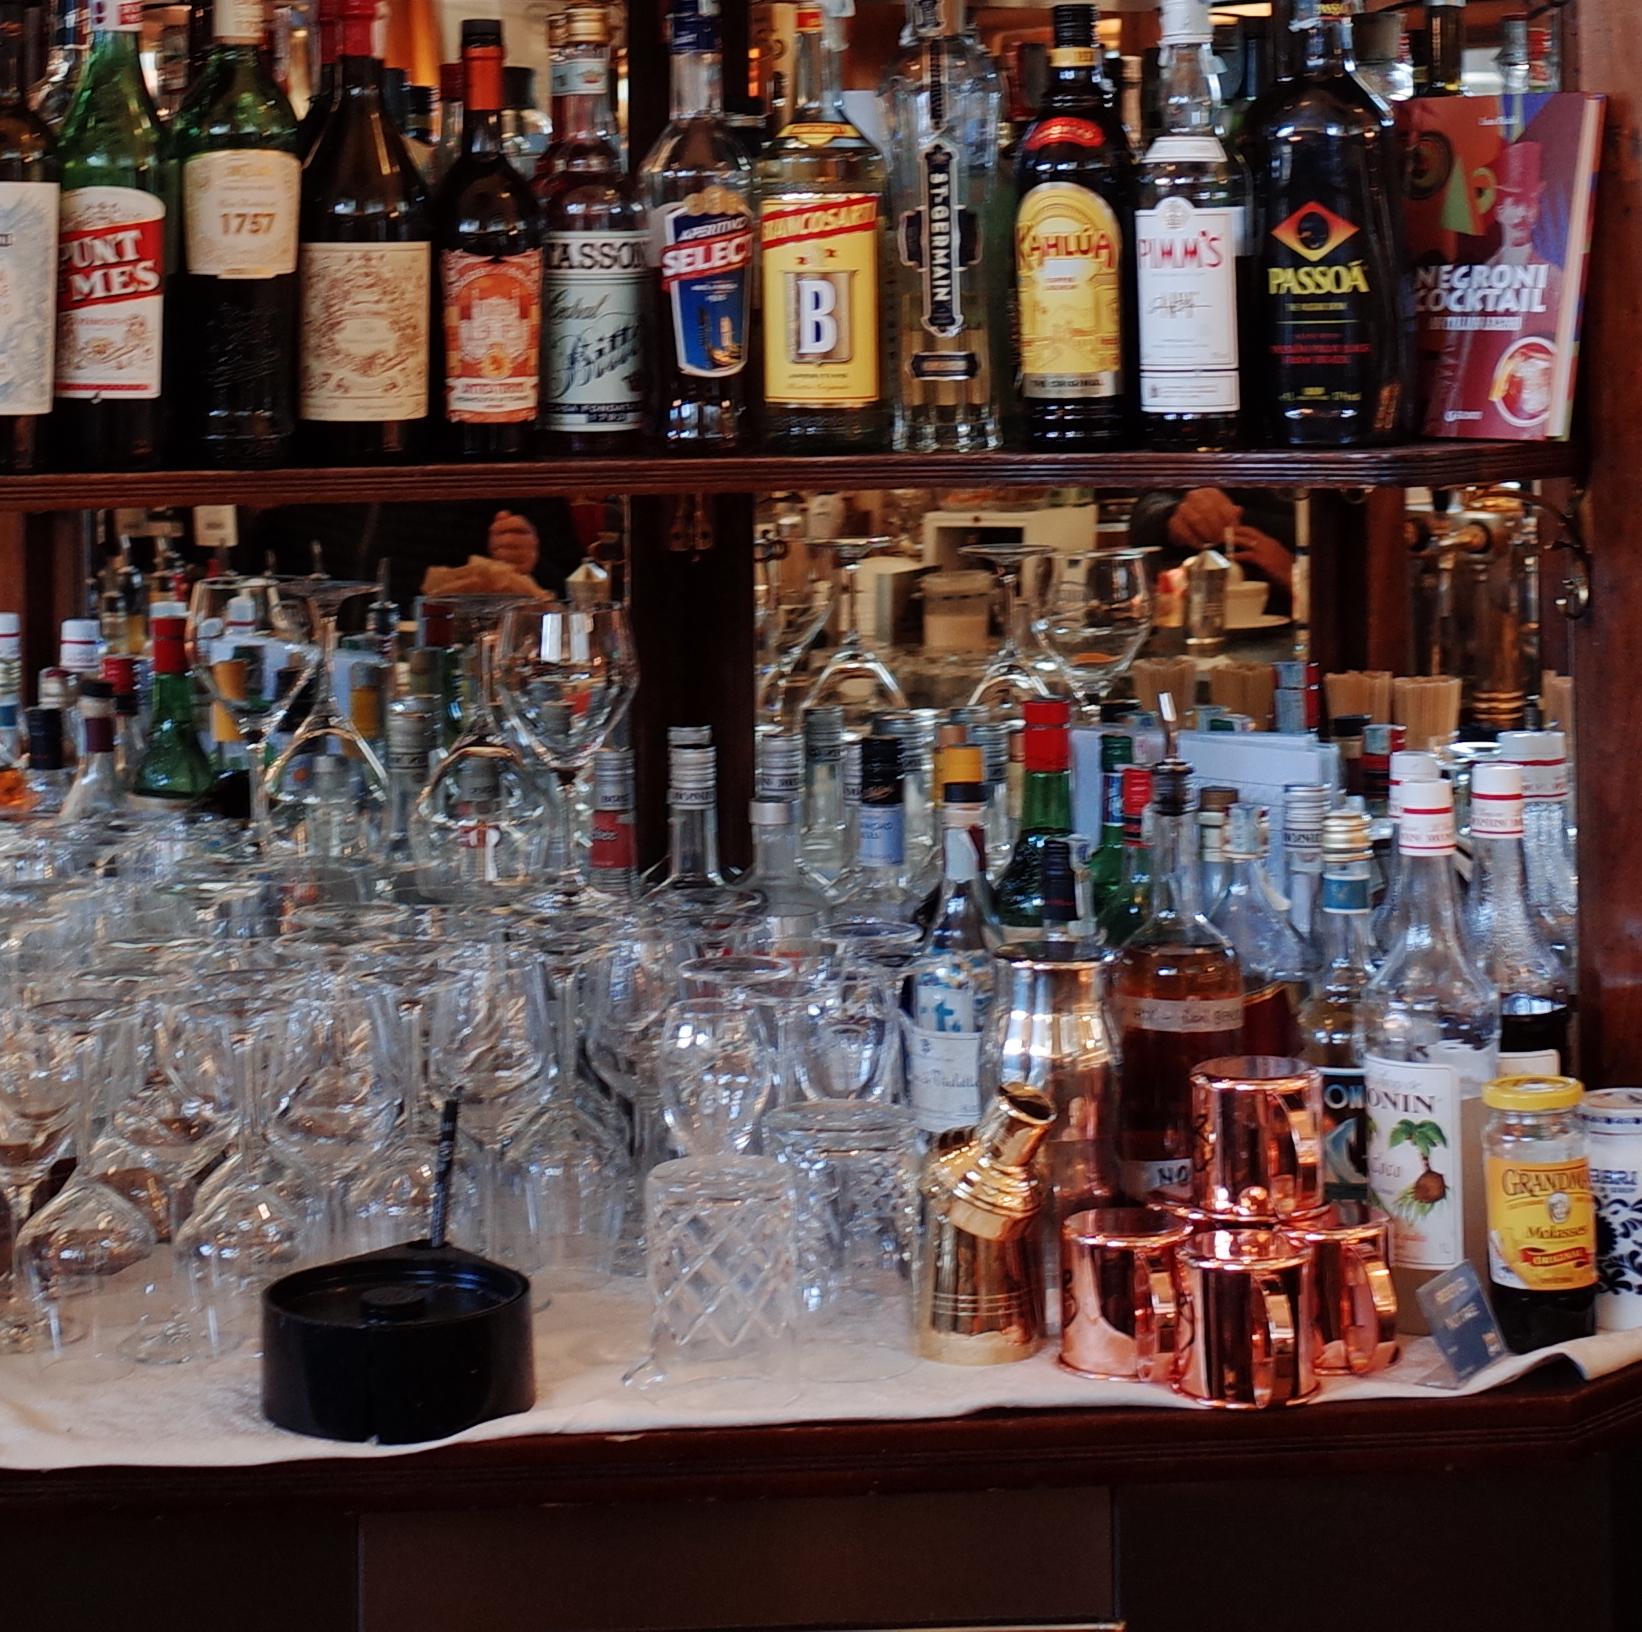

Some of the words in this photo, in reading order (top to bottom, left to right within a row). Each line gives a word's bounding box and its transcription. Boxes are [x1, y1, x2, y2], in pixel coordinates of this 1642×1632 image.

[220, 212, 278, 236] 1757
[661, 233, 755, 278] SELECT
[1138, 229, 1225, 269] PIMM'S
[69, 259, 162, 303] MES
[1415, 264, 1550, 289] NEGRONI
[1413, 288, 1547, 313] COCKTAIL
[796, 278, 839, 355] B
[1365, 1087, 1437, 1114] ONIN
[1589, 1168, 1639, 1186] BBRI
[1525, 1224, 1588, 1240] Molasses
